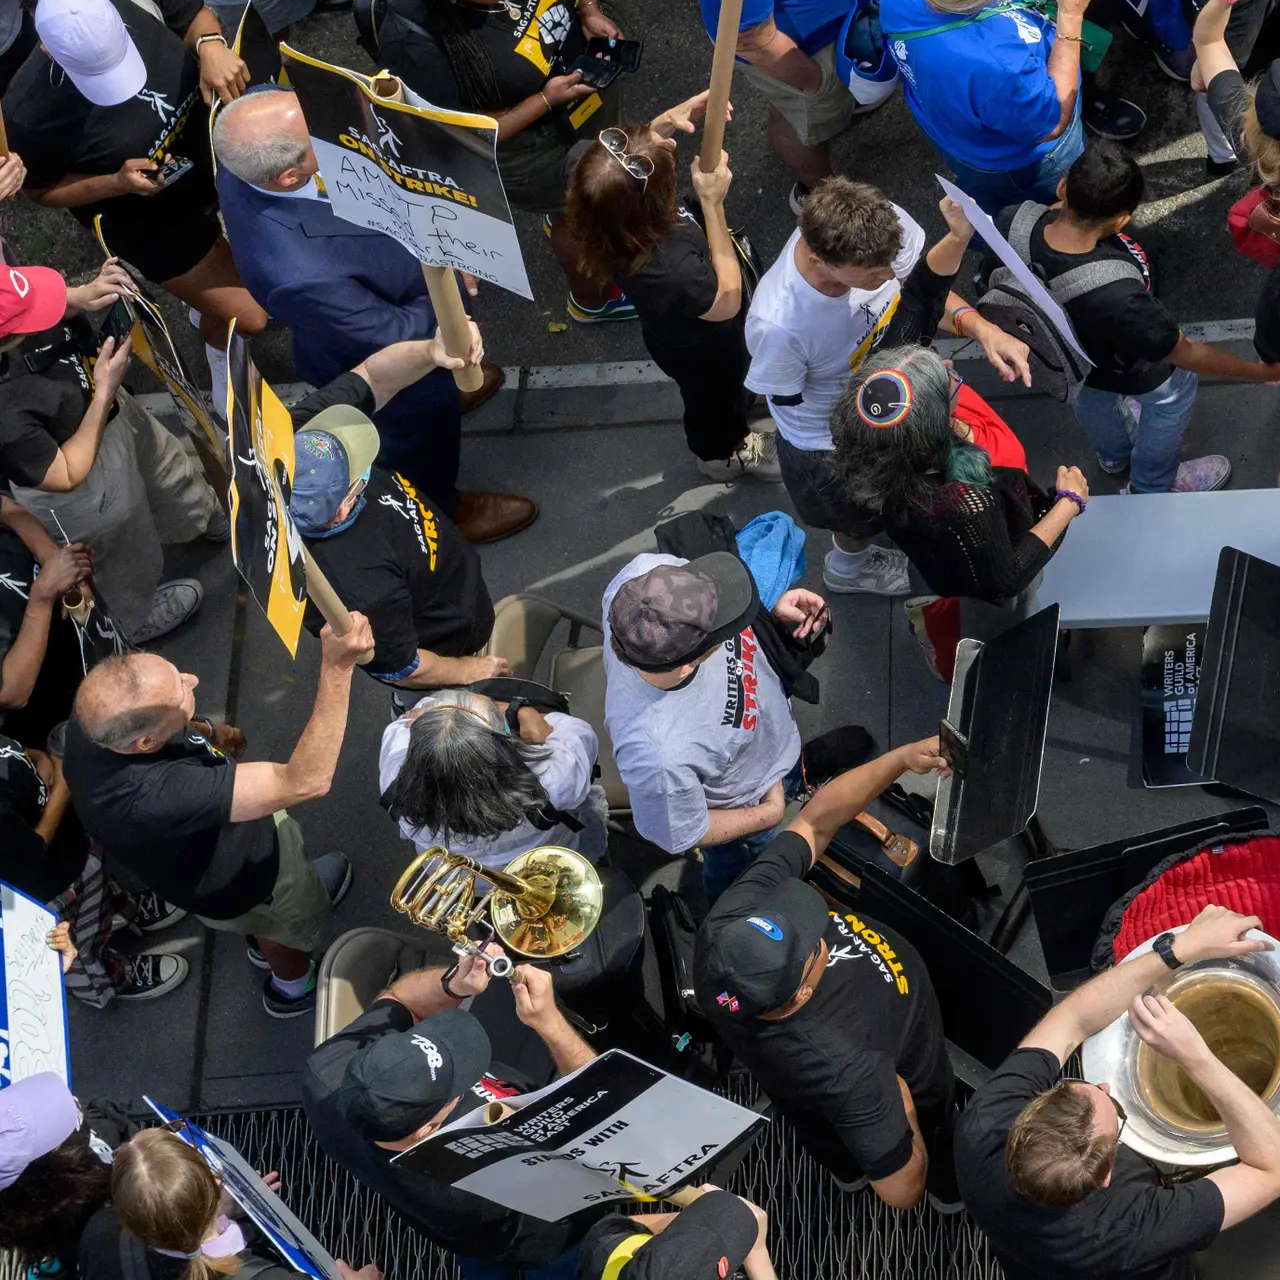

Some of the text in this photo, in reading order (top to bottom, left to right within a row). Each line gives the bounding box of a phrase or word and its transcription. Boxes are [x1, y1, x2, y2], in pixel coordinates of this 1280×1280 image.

[338, 133, 371, 162] ON
[1163, 650, 1176, 698] WRITERS
[1186, 631, 1197, 682] AMERICA
[721, 654, 740, 728] WRITERS
[1174, 661, 1185, 696] GUILD
[514, 1095, 576, 1133] WRITERS
[522, 1109, 565, 1139] GUILD
[544, 1089, 610, 1134] AMERICA
[535, 1119, 573, 1143] EAST
[586, 1119, 631, 1149] WITH
